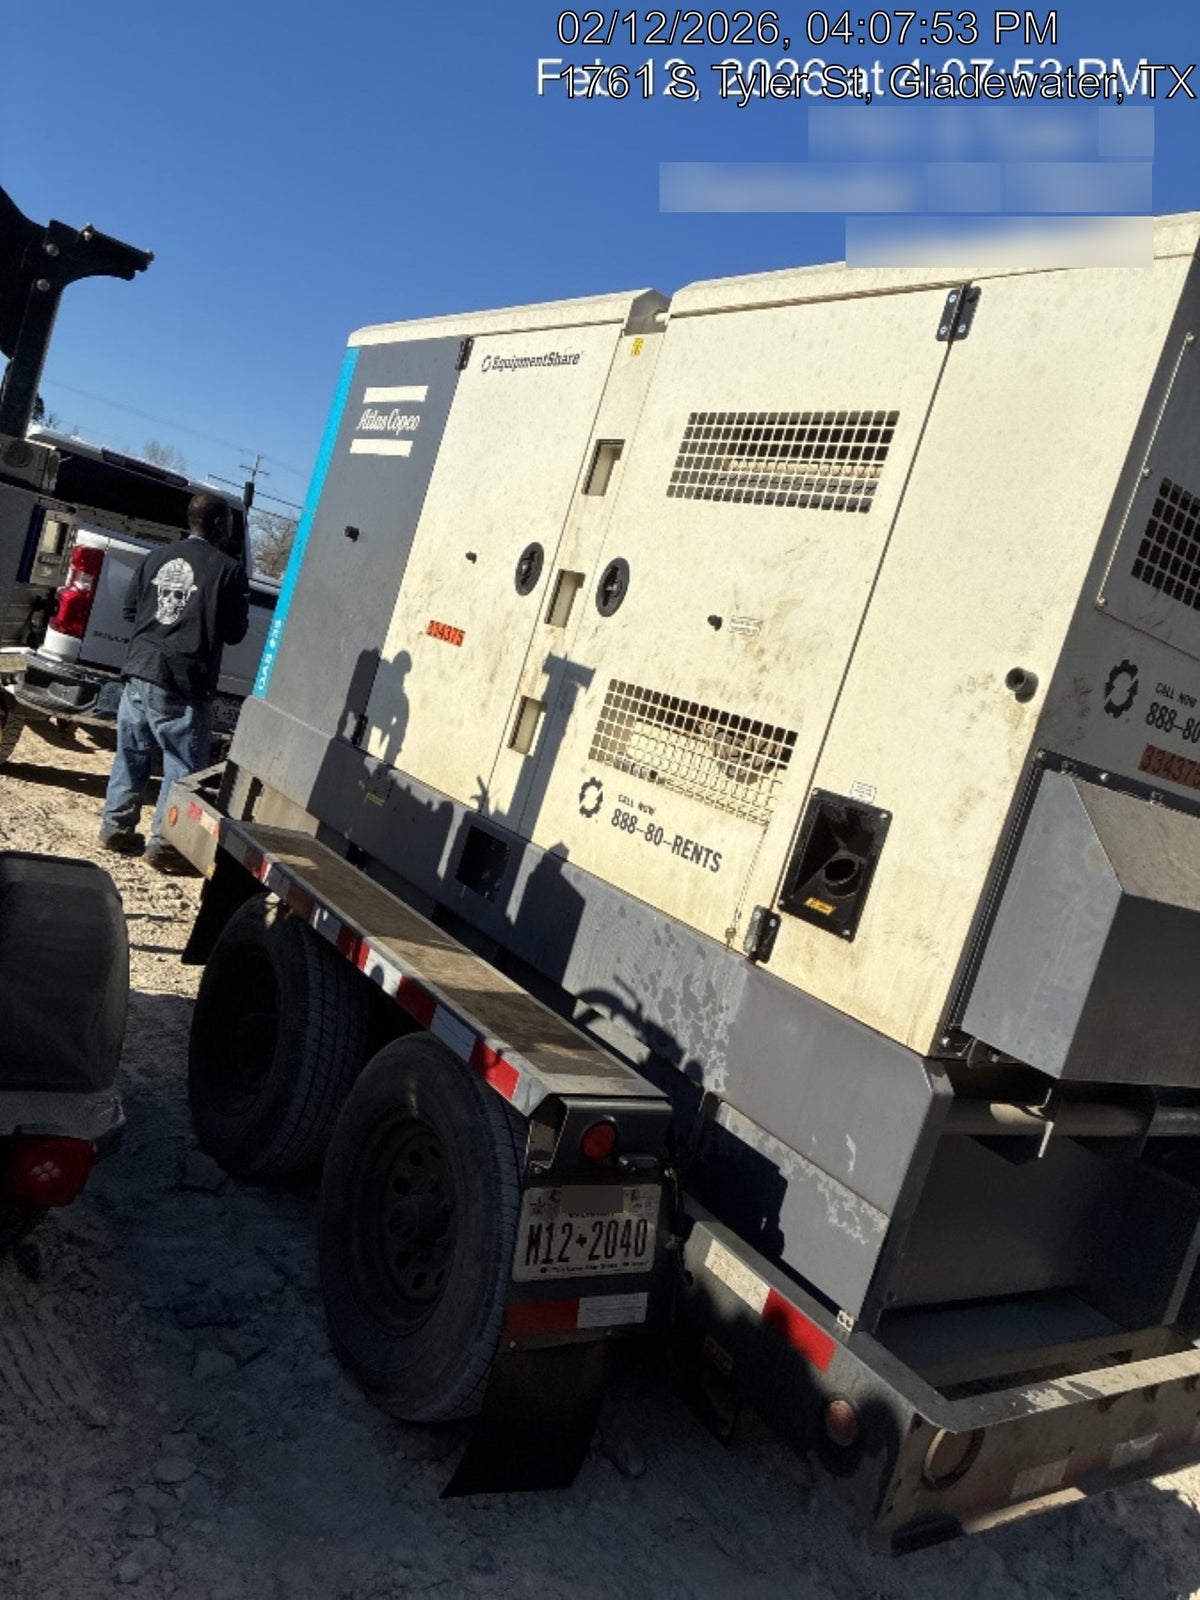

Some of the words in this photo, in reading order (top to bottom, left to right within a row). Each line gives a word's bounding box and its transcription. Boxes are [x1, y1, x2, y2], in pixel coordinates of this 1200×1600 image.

[491, 352, 581, 372] EquipmentShare
[356, 409, 387, 431] Atlas
[387, 408, 421, 435] Copco
[1155, 682, 1175, 699] CALL
[1177, 691, 1198, 708] NOW
[618, 794, 635, 808] CALL
[638, 801, 656, 816] NOW
[611, 808, 722, 873] 888-80-RENTS
[588, 1218, 649, 1261] 2040
